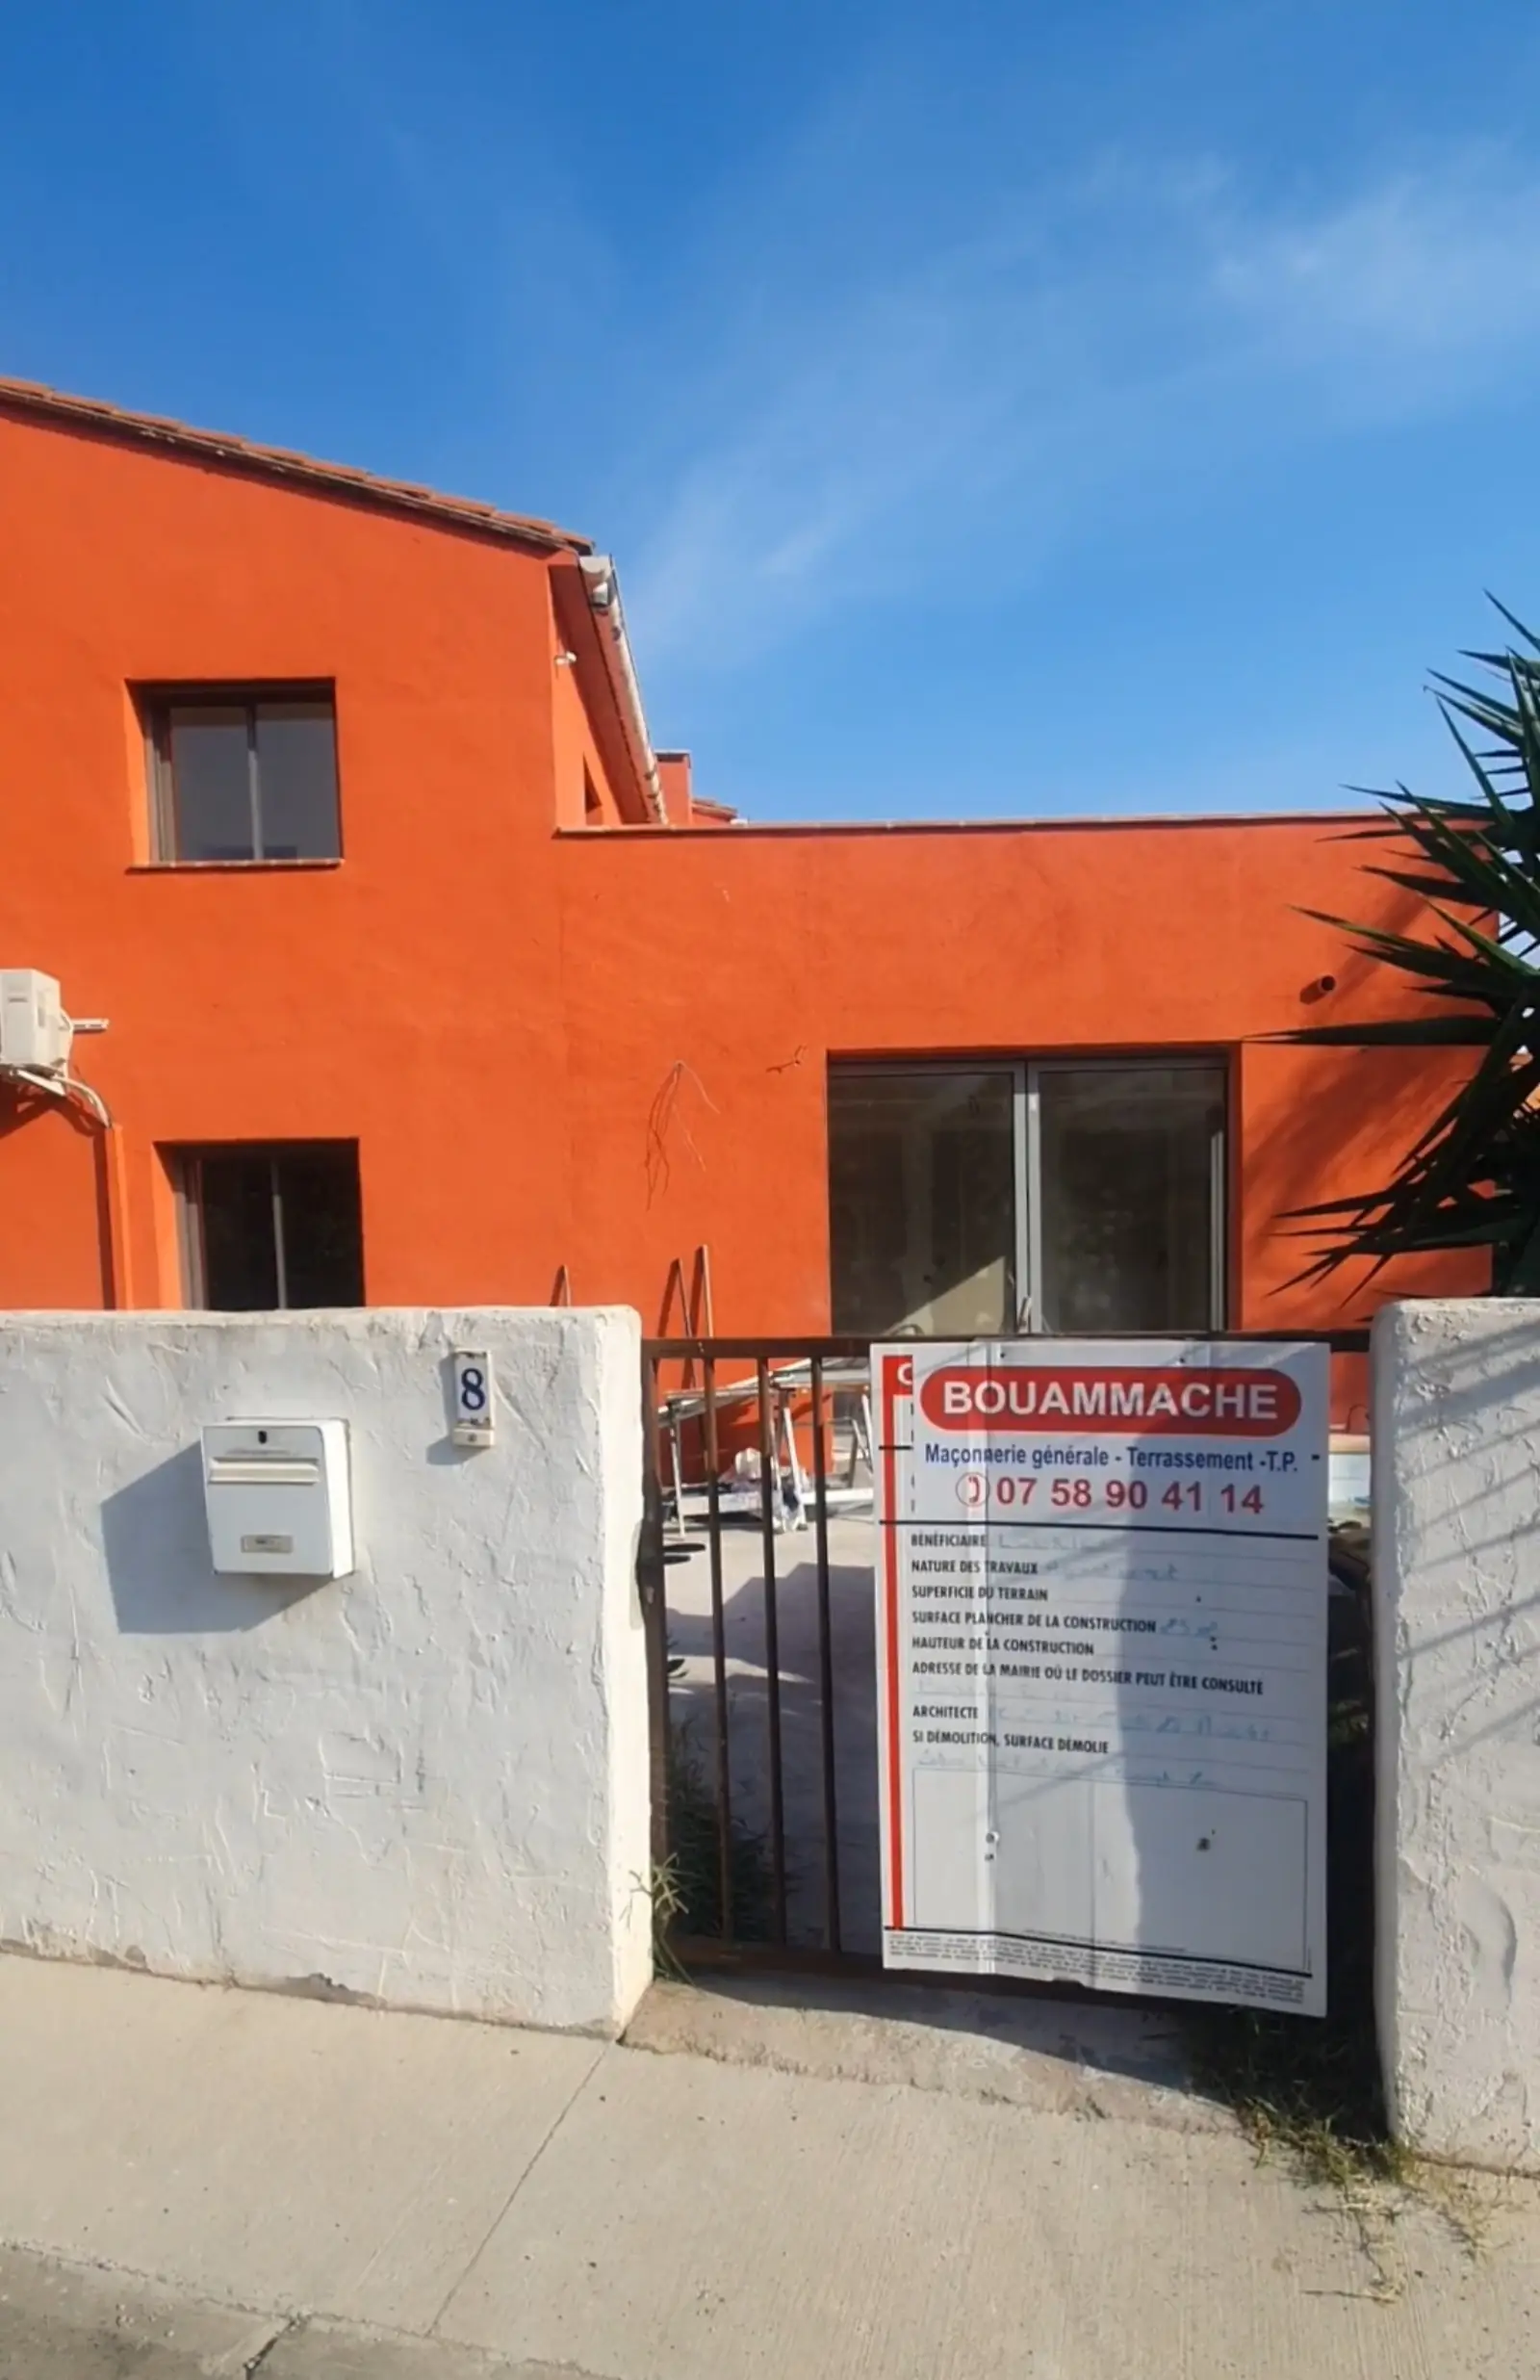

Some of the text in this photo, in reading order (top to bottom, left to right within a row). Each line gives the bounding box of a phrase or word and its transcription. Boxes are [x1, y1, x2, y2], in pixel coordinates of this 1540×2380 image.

[461, 1368, 486, 1410] 8
[943, 1381, 1278, 1419] BOUAMMACHE
[925, 1443, 1027, 1466] Maçonnerie
[1032, 1446, 1109, 1470] générale
[1126, 1446, 1253, 1471] Terrassement
[996, 1476, 1265, 1514] 07 58 90 41 14
[911, 1532, 987, 1548] BÉNÉFICIAIRE
[911, 1559, 956, 1573] NATURE
[960, 1560, 981, 1573] DES
[985, 1561, 1039, 1575] TRAVAUX
[911, 1585, 1048, 1601] SUPERFICIE DU TERRAIN
[911, 1611, 961, 1624] SURFACE
[964, 1612, 1023, 1626] PLANCHER
[1027, 1614, 1041, 1626] DE
[1045, 1615, 1060, 1628] LA
[1064, 1616, 1156, 1633] CONSTRUCTION
[911, 1637, 1094, 1655] HAUTEUR DE LA CONSTRUCTION
[912, 1662, 961, 1675] ADRESSE
[964, 1663, 979, 1676] DE
[982, 1664, 996, 1677] LA
[999, 1665, 1040, 1679] MAIRIE
[1065, 1668, 1077, 1681] LE
[1082, 1669, 1132, 1684] DOSSIER
[1136, 1671, 1166, 1687] PEUT
[1169, 1670, 1197, 1690] ÊTRE
[912, 1705, 978, 1720] ARCHITECTE
[912, 1730, 923, 1743] SI
[1004, 1733, 1054, 1750] SURFACE
[1057, 1736, 1109, 1754] DÉMOLIE
